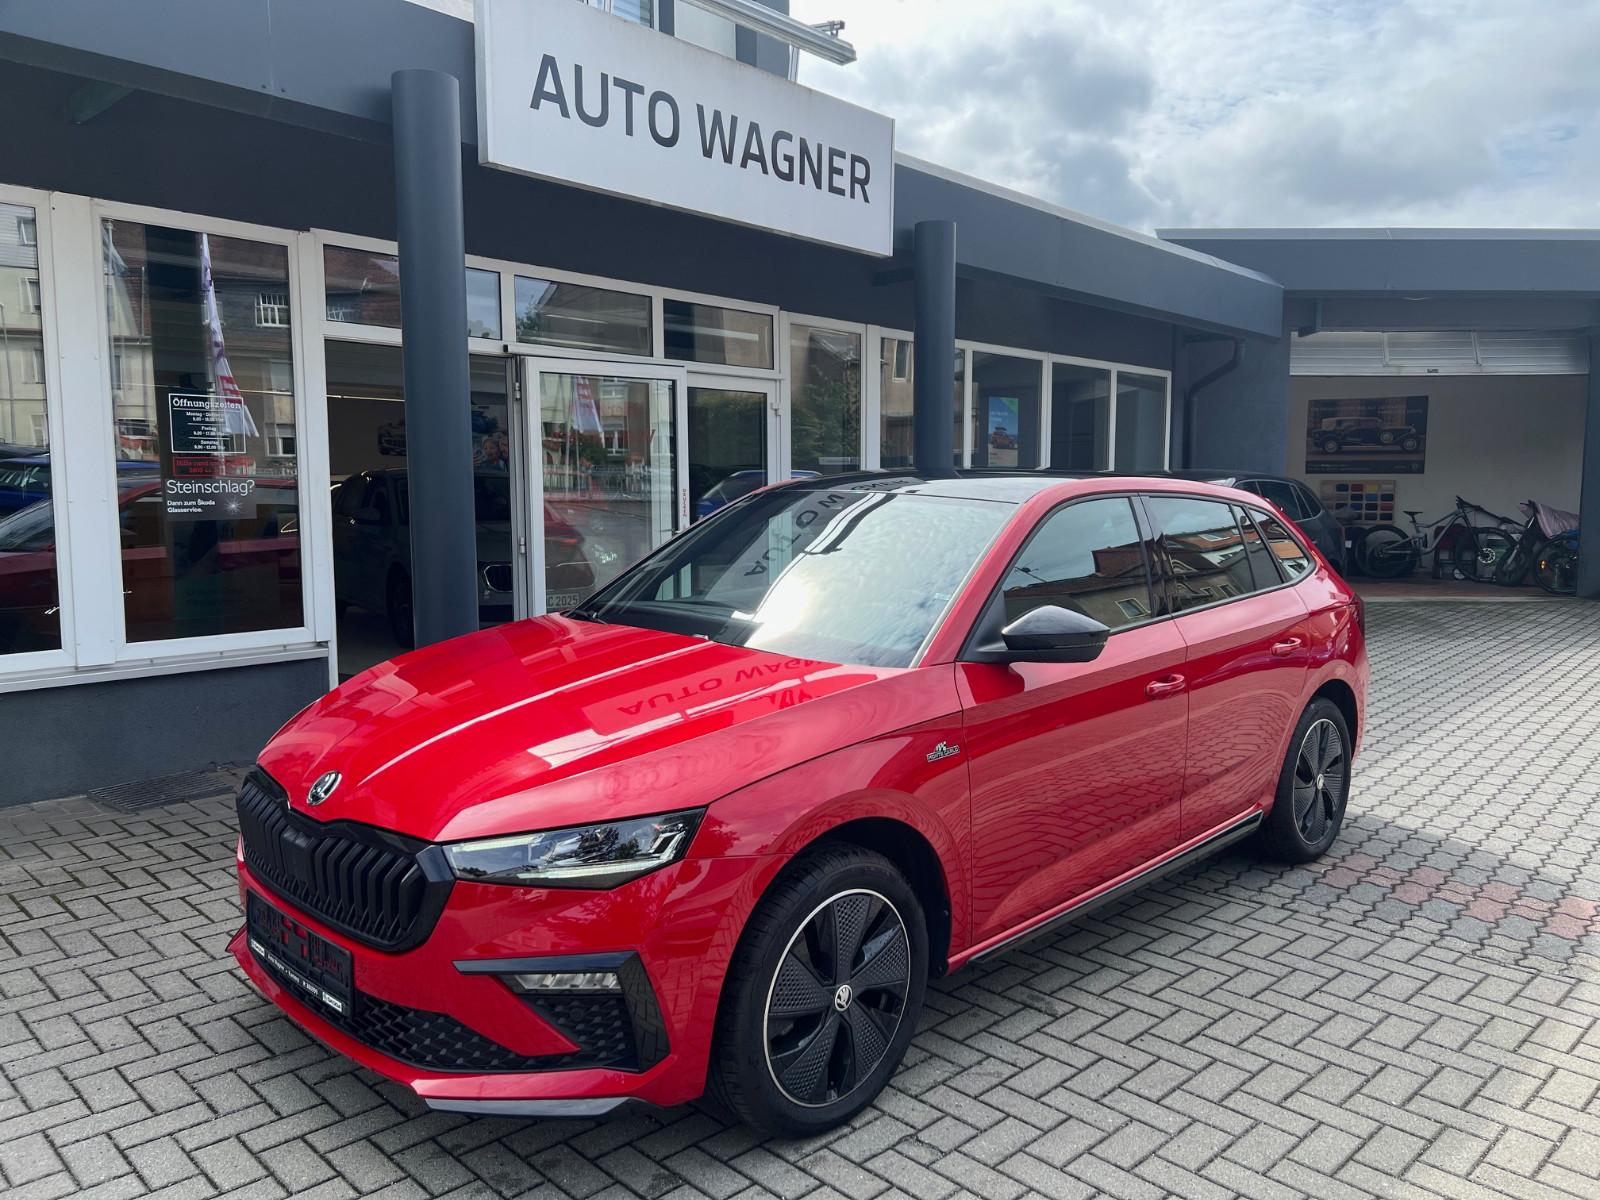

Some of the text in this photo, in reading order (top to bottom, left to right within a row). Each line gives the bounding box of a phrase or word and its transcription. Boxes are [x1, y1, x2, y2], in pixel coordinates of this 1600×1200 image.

[530, 53, 871, 203] AUTO WAGNER
[166, 479, 255, 496] Steinschlag?
[197, 498, 216, 506] Škoda
[555, 594, 578, 607] 2025
